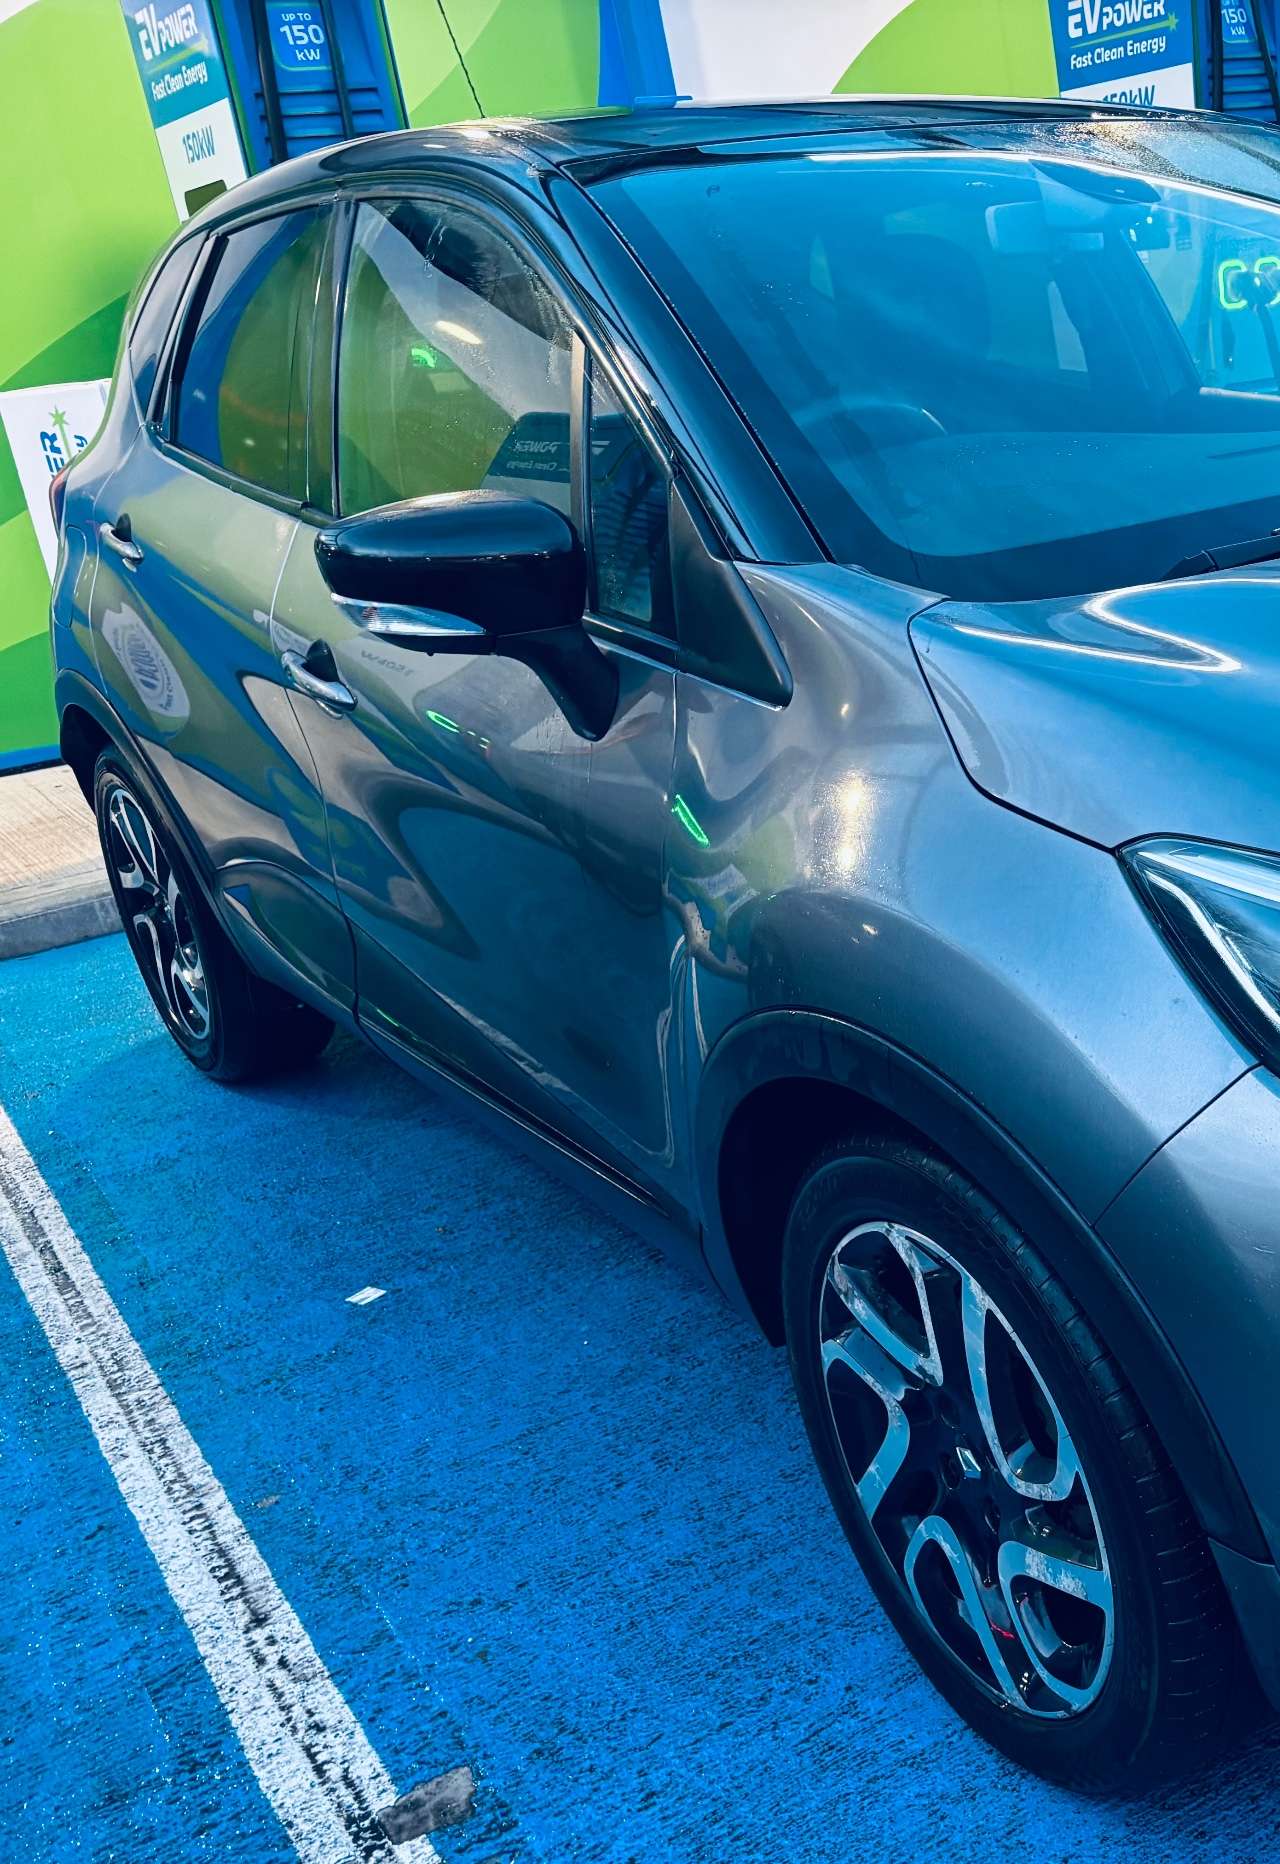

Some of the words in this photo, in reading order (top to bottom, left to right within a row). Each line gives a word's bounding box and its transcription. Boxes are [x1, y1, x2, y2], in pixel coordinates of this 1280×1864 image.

[281, 13, 295, 22] UP
[296, 12, 312, 21] TO
[1221, 8, 1247, 24] 150
[280, 24, 325, 45] 150
[1230, 25, 1246, 35] kW
[296, 48, 321, 61] kW
[1070, 53, 1093, 70] Fast
[1094, 46, 1125, 64] Clean
[1127, 35, 1167, 56] Energy
[151, 80, 166, 101] Fast
[165, 72, 183, 96] Clean
[183, 60, 209, 88] Energy
[182, 125, 216, 164] 150kW
